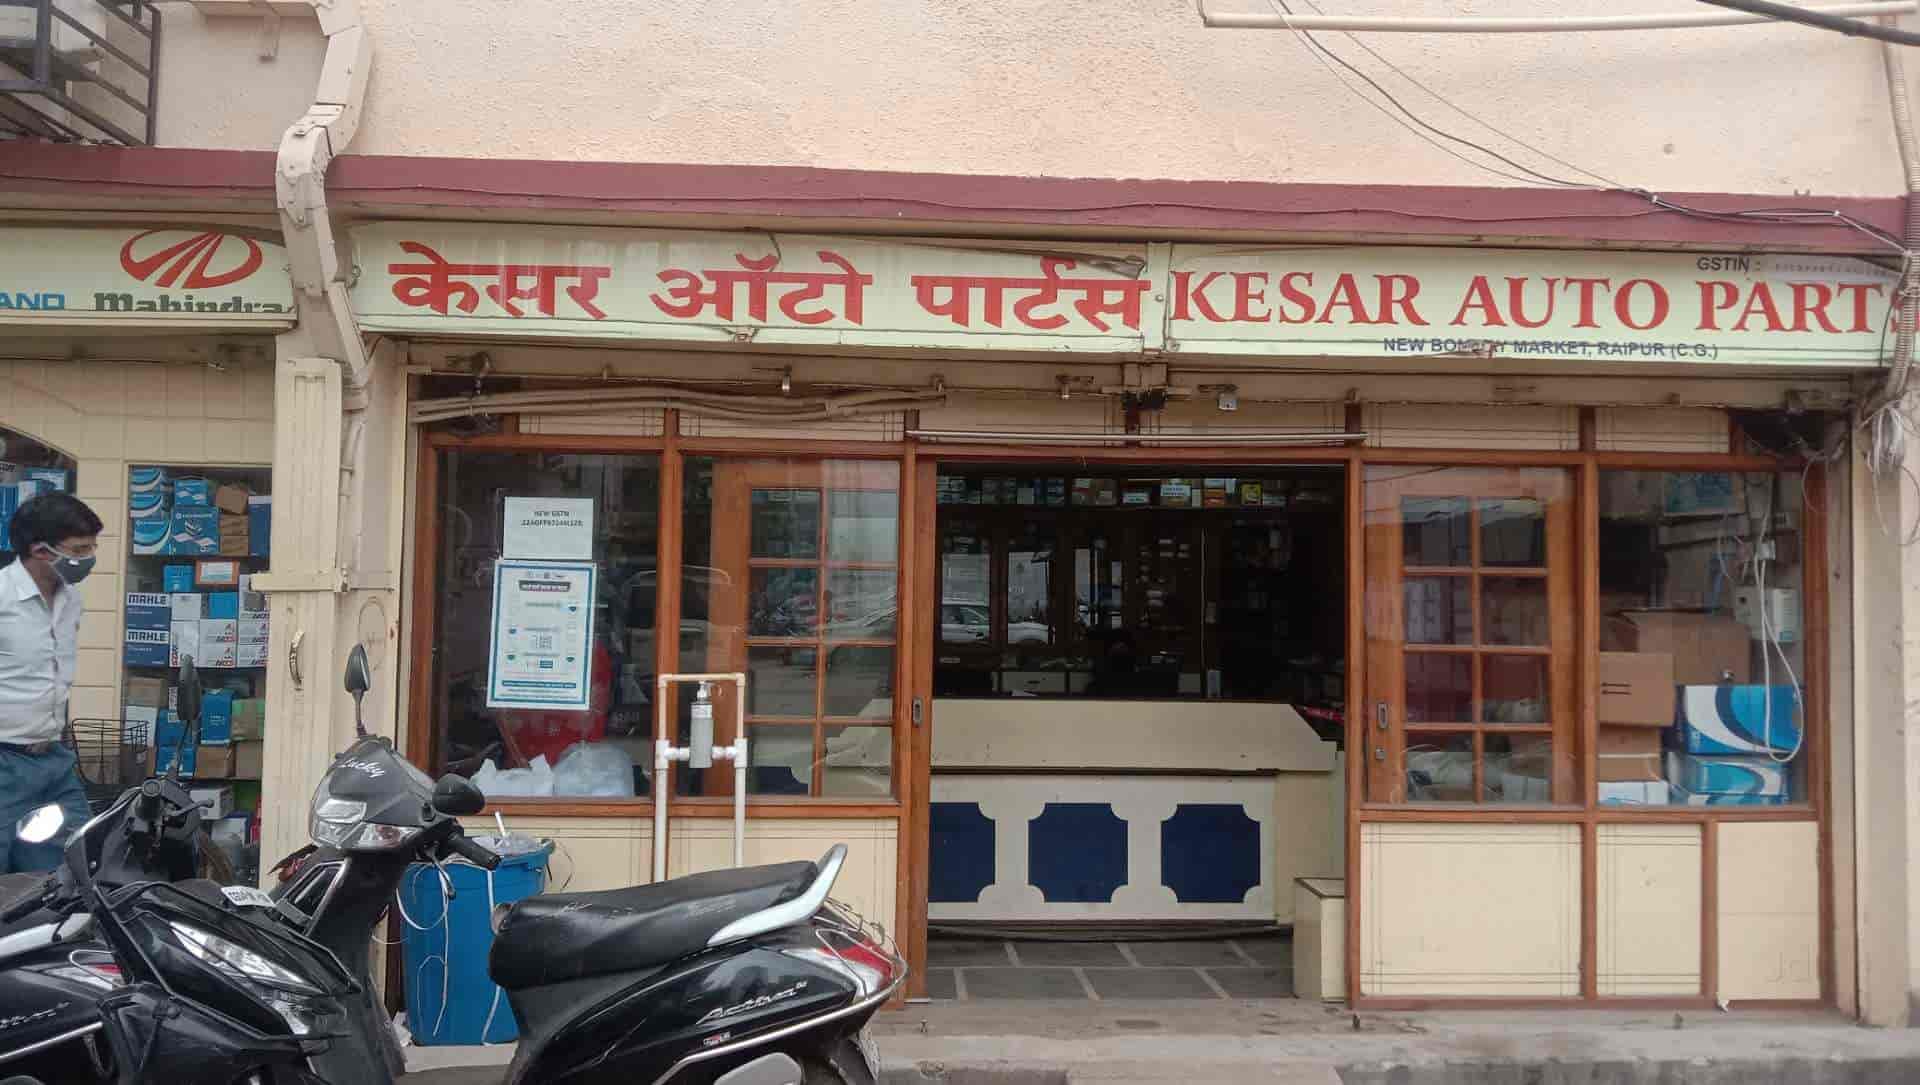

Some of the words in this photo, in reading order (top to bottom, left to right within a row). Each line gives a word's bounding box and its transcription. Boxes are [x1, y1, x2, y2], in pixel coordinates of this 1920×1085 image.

[1696, 256, 1750, 272] GSTIN
[388, 241, 611, 320] केसर
[648, 252, 873, 326] ऑटो
[94, 292, 283, 313] Mahindra
[1170, 269, 1428, 328] KESAR
[1454, 275, 1671, 331] AUTO
[1383, 337, 1424, 352] NEW
[1513, 340, 1592, 358] MARKET,
[1598, 342, 1666, 357] RAIPUR
[1670, 342, 1719, 360] (C.G.)
[128, 593, 167, 605] MAHLE
[127, 631, 167, 642] MAHLE
[337, 757, 385, 778] Lucky
